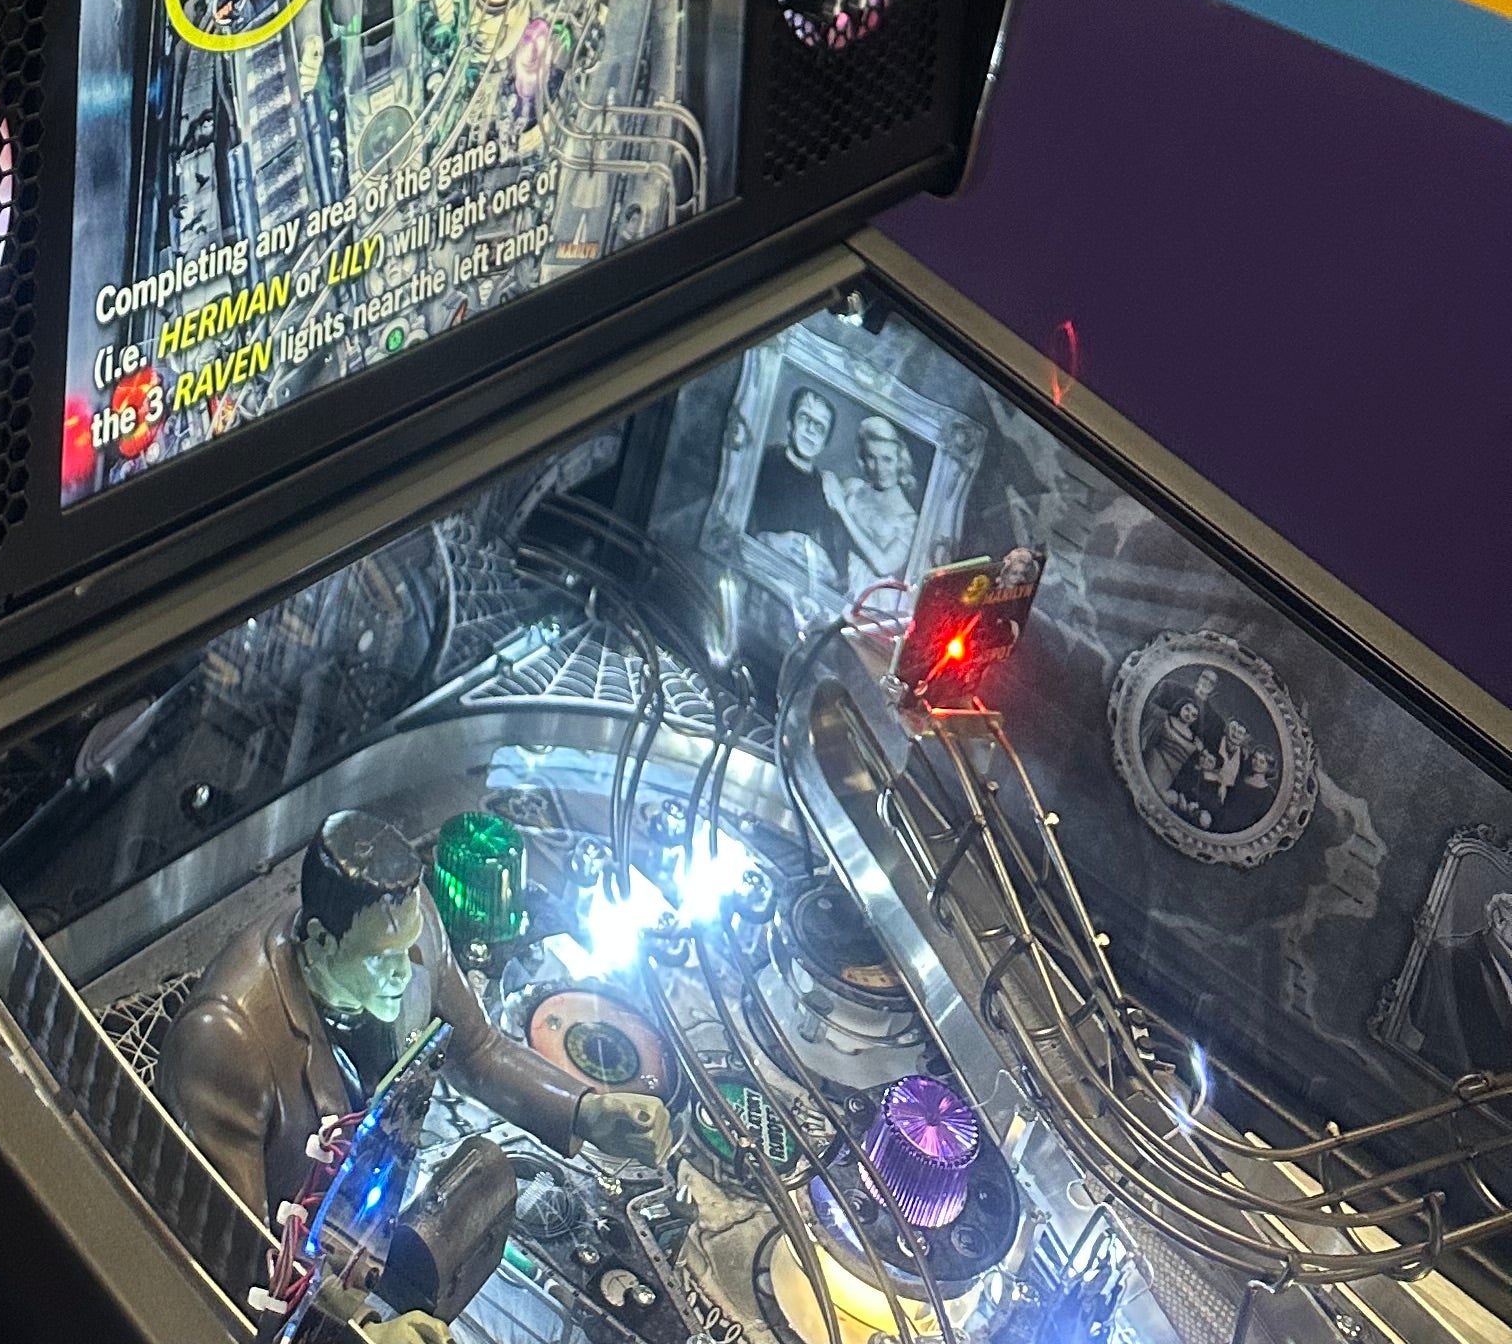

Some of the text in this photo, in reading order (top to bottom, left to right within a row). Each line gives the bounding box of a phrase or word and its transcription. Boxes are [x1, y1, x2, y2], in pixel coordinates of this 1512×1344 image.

[90, 222, 555, 449] the 3 RAVEN lights near the left ramp.
[94, 160, 558, 390] (i.e. HERMAN or LILY) will light one of
[95, 140, 498, 324] Completing any area of the game
